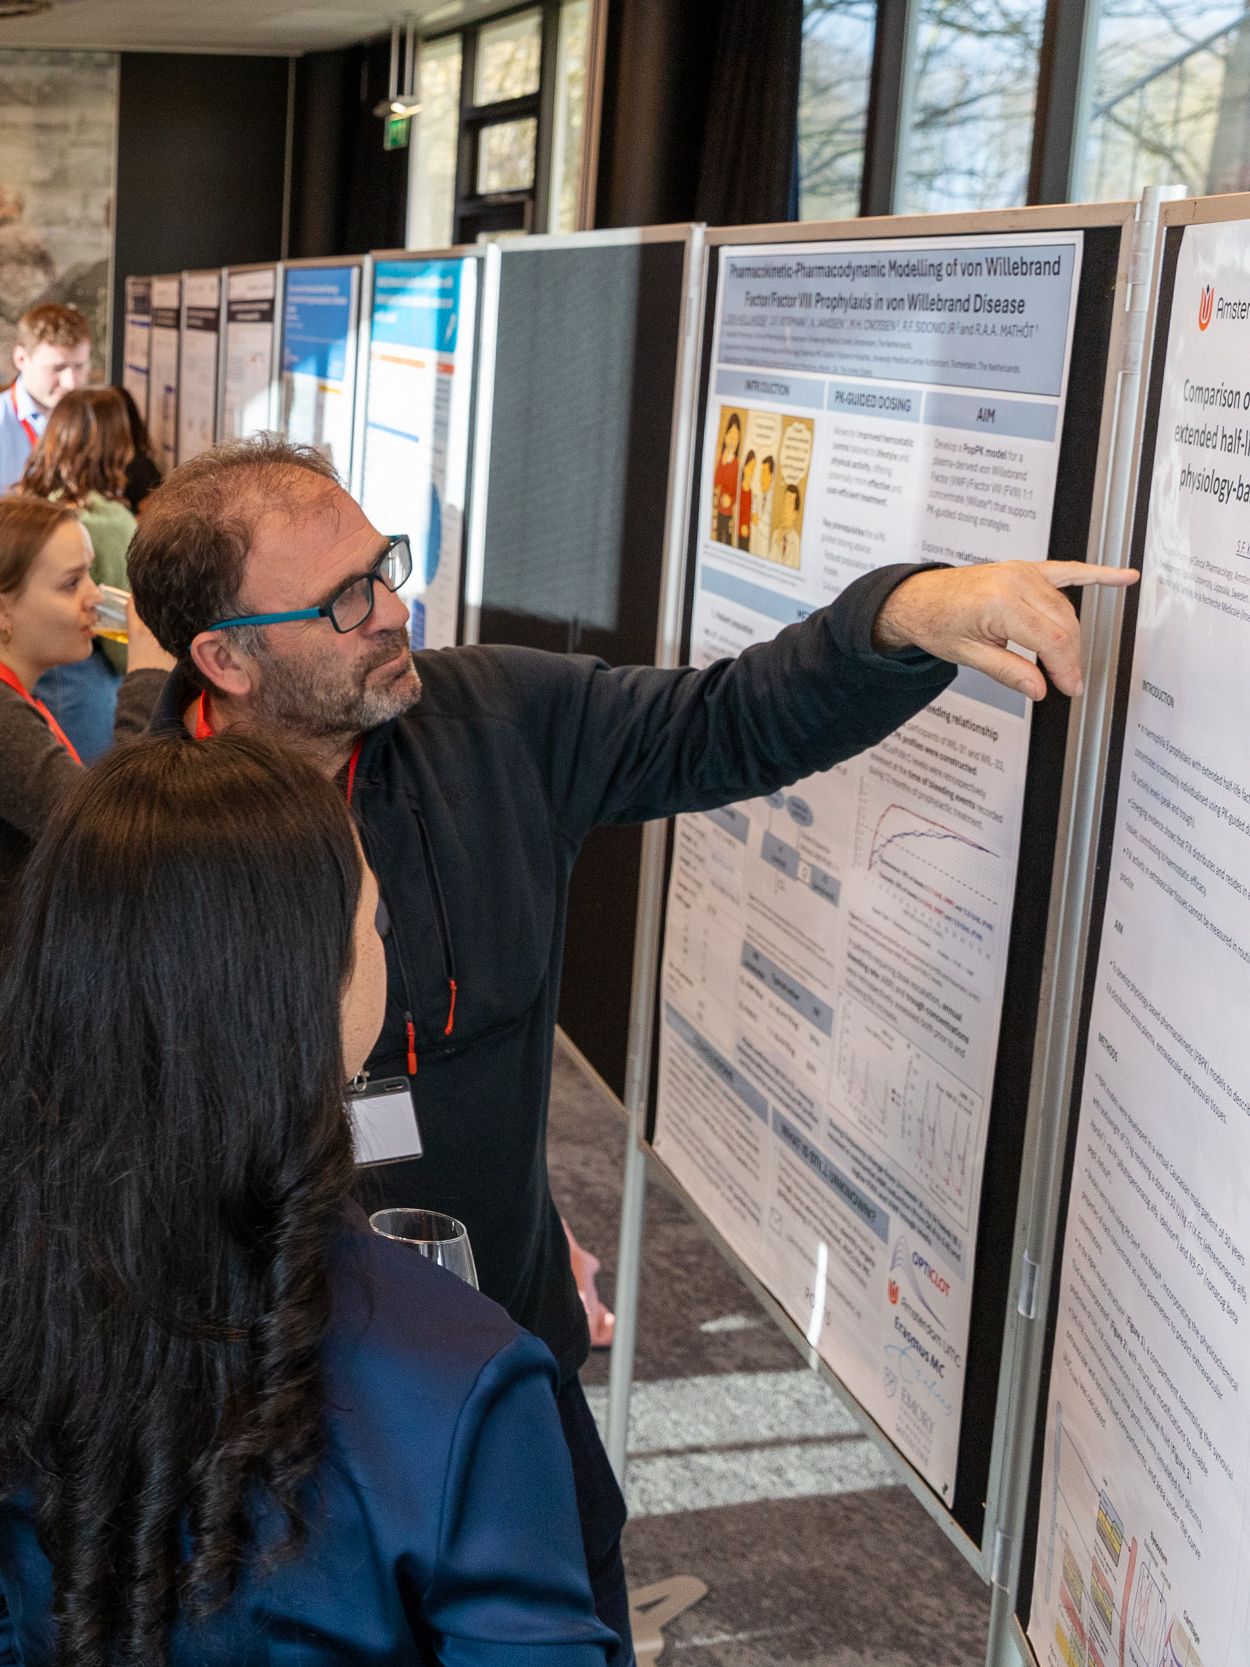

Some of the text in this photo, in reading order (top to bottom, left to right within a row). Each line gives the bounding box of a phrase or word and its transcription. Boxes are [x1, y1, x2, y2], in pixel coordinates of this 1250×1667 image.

[887, 257, 944, 283] Modelling
[944, 256, 959, 278] of
[959, 262, 983, 278] von
[983, 254, 1061, 278] Willebrand
[813, 291, 873, 314] Prophylaxis
[884, 297, 905, 312] von
[906, 292, 971, 314] Willebrand
[972, 293, 1025, 316] Disease
[1183, 378, 1241, 411] Comparison
[976, 406, 996, 426] AIM
[1173, 422, 1219, 450] extended
[984, 447, 1006, 461] model
[1141, 680, 1175, 708] INTRODUCTION
[1168, 743, 1191, 765] prophylaxis
[1201, 765, 1223, 786] extended
[1222, 777, 1240, 798] half-life
[1208, 801, 1220, 818] using
[1220, 807, 1246, 834] PK-guided
[1192, 846, 1215, 873] distributes
[1215, 867, 1225, 881] and
[1224, 874, 1241, 894] resides
[1209, 922, 1231, 948] measured
[1209, 1067, 1226, 1091] models
[1182, 1069, 1191, 1085] and
[1191, 1079, 1210, 1105] synovial
[1209, 1096, 1227, 1125] tissues.
[1169, 1162, 1190, 1197] Caucasian
[1190, 1191, 1200, 1211] male
[1200, 1205, 1218, 1233] patient
[1230, 1243, 1244, 1267] years
[911, 1248, 949, 1299] OPTICLOT
[1226, 1301, 1237, 1326] beta
[893, 1314, 945, 1383] Erasmus MC
[1199, 1333, 1238, 1394] physicochemical
[1191, 1447, 1207, 1477] enable
[1187, 1533, 1200, 1561] curve
